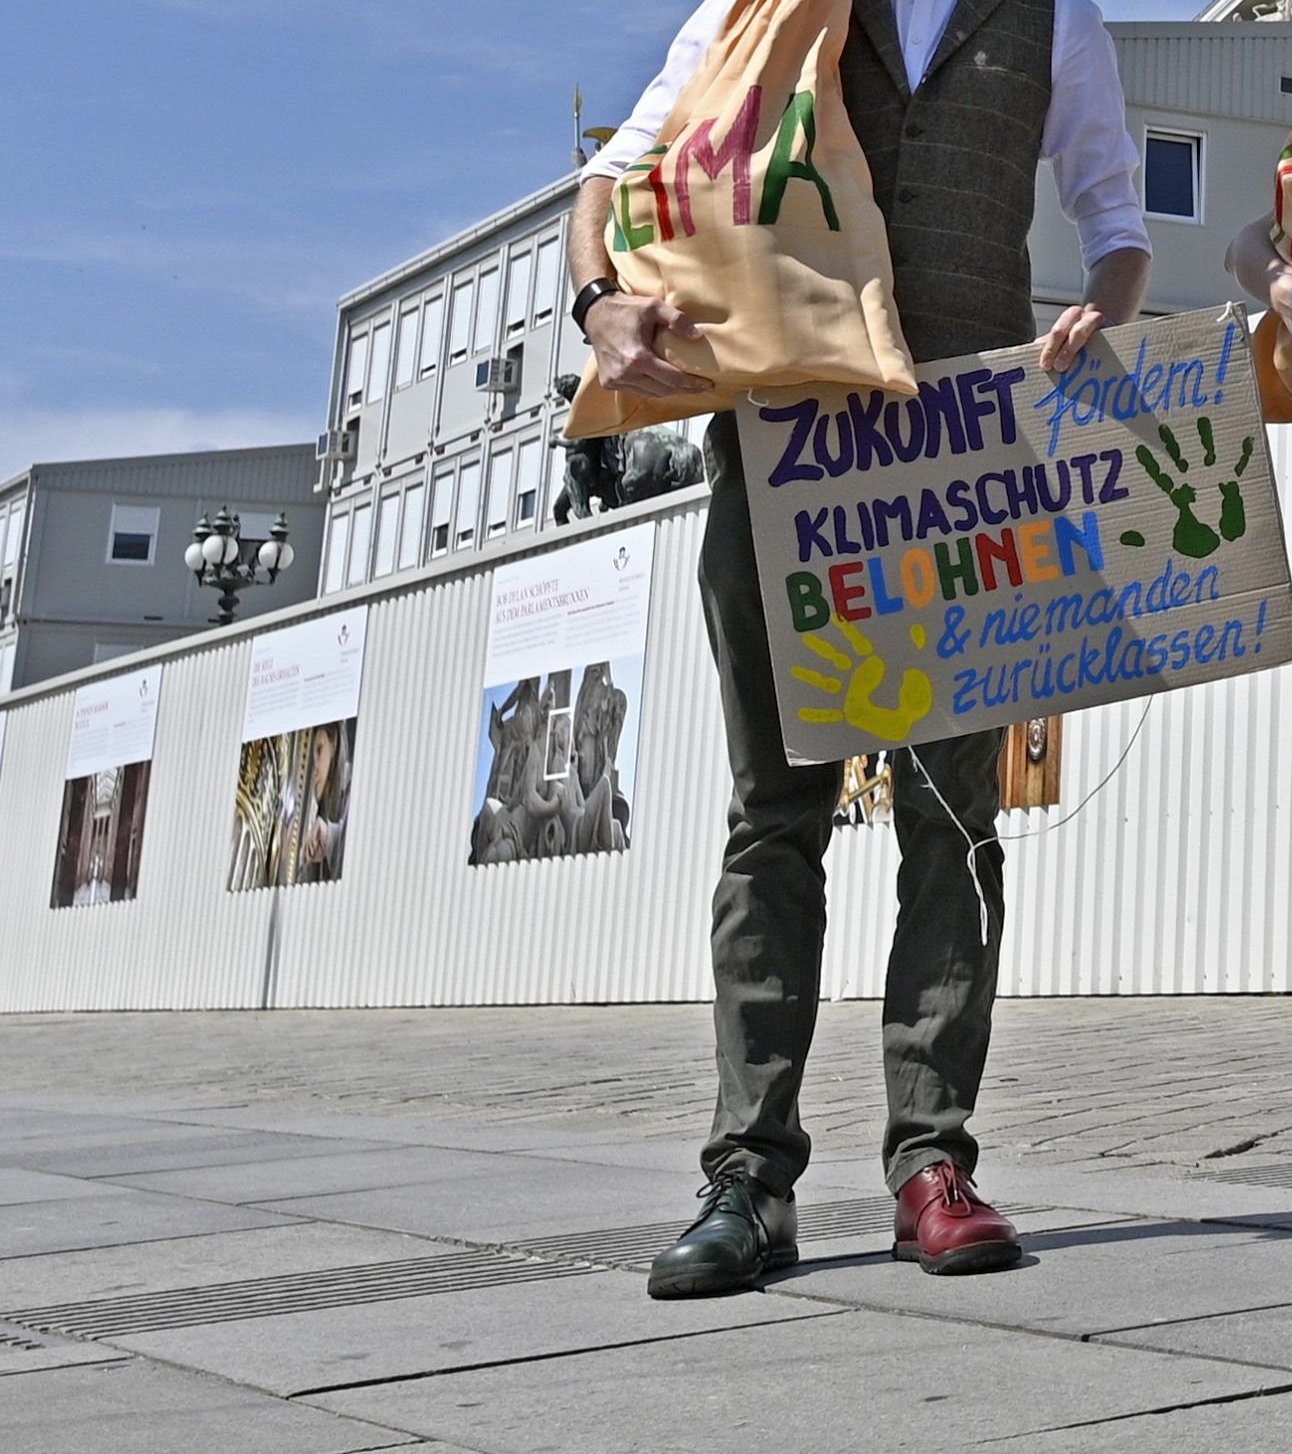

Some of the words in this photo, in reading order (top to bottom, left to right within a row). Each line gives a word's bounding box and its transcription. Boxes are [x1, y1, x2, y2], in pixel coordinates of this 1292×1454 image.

[759, 366, 1026, 488] ZUKUNFT
[1033, 322, 1236, 457] fördern!
[793, 448, 1130, 563] KLIMASCHUTZ
[785, 511, 1105, 633] BELOHNEN
[978, 558, 1220, 648] niemanden
[951, 599, 1268, 715] zurücklassen!
